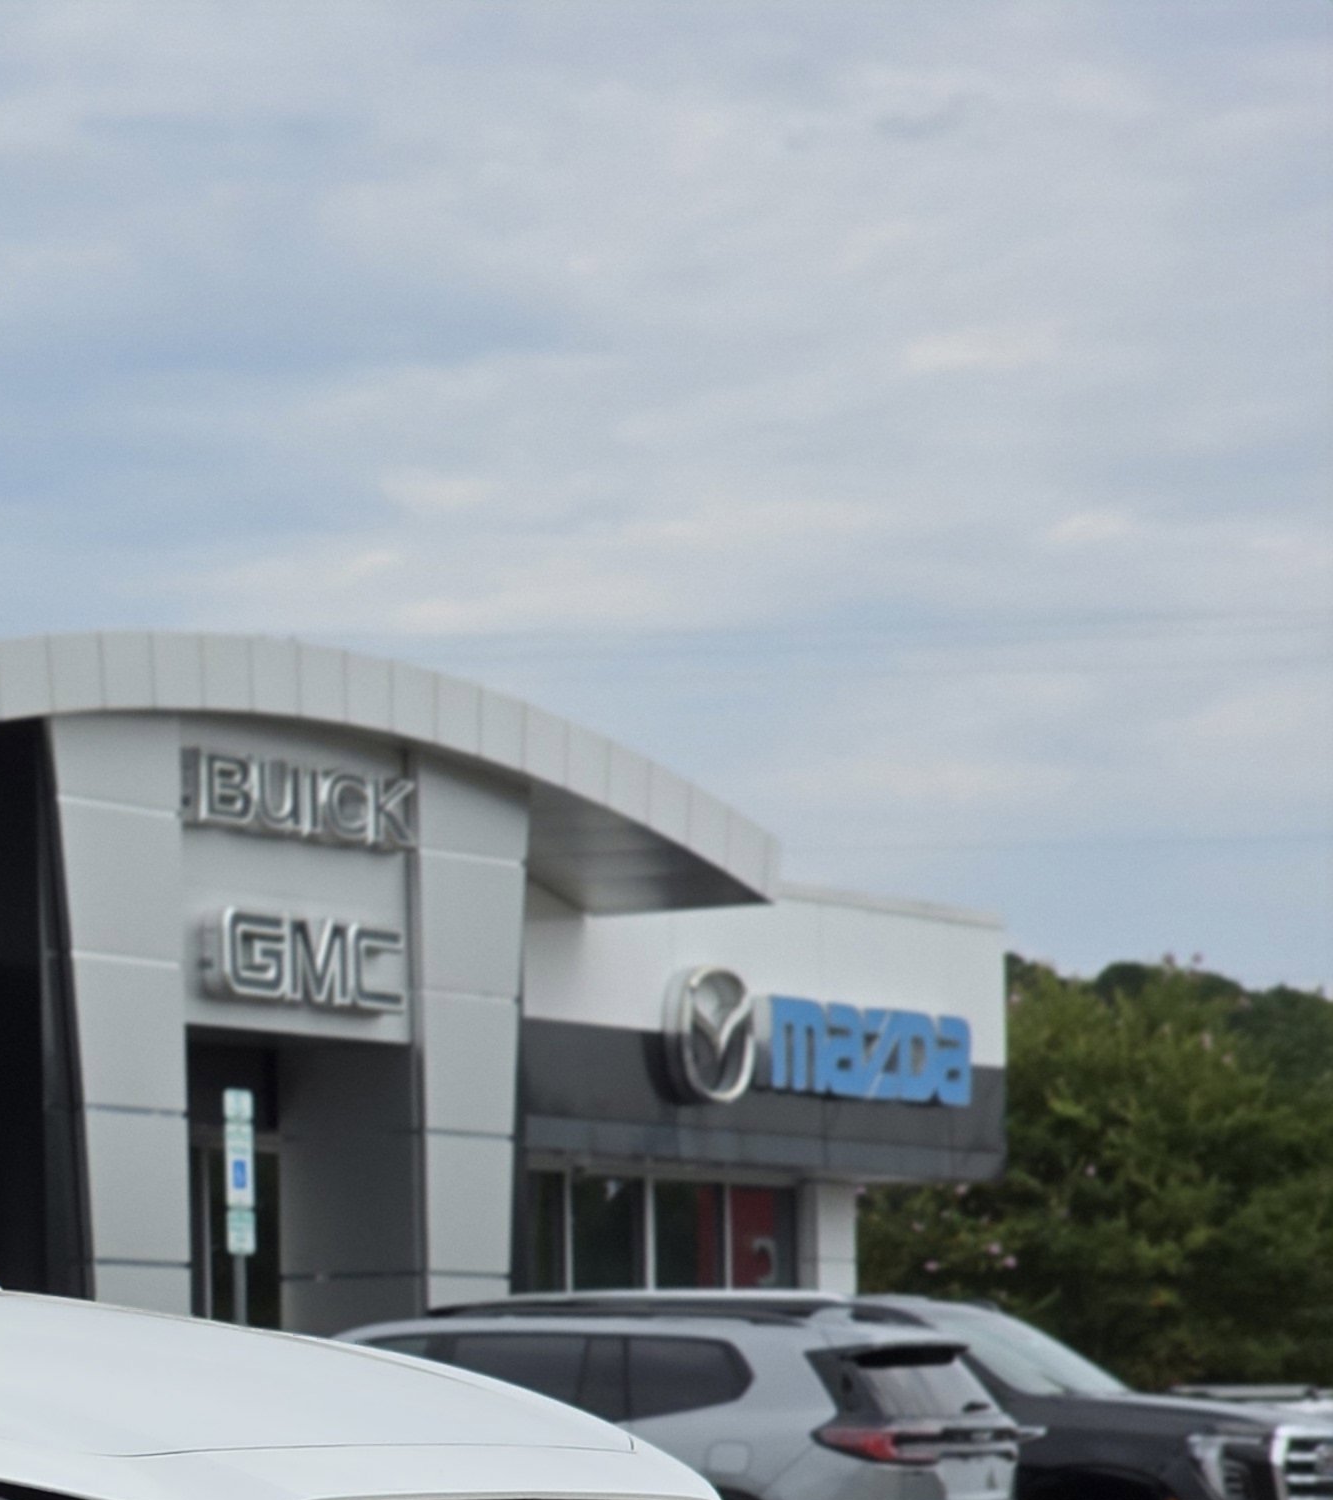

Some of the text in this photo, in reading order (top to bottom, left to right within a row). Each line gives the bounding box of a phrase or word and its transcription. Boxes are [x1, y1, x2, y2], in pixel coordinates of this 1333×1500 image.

[199, 751, 416, 847] BUICK
[223, 906, 405, 1014] GMC
[768, 993, 972, 1107] mazda
